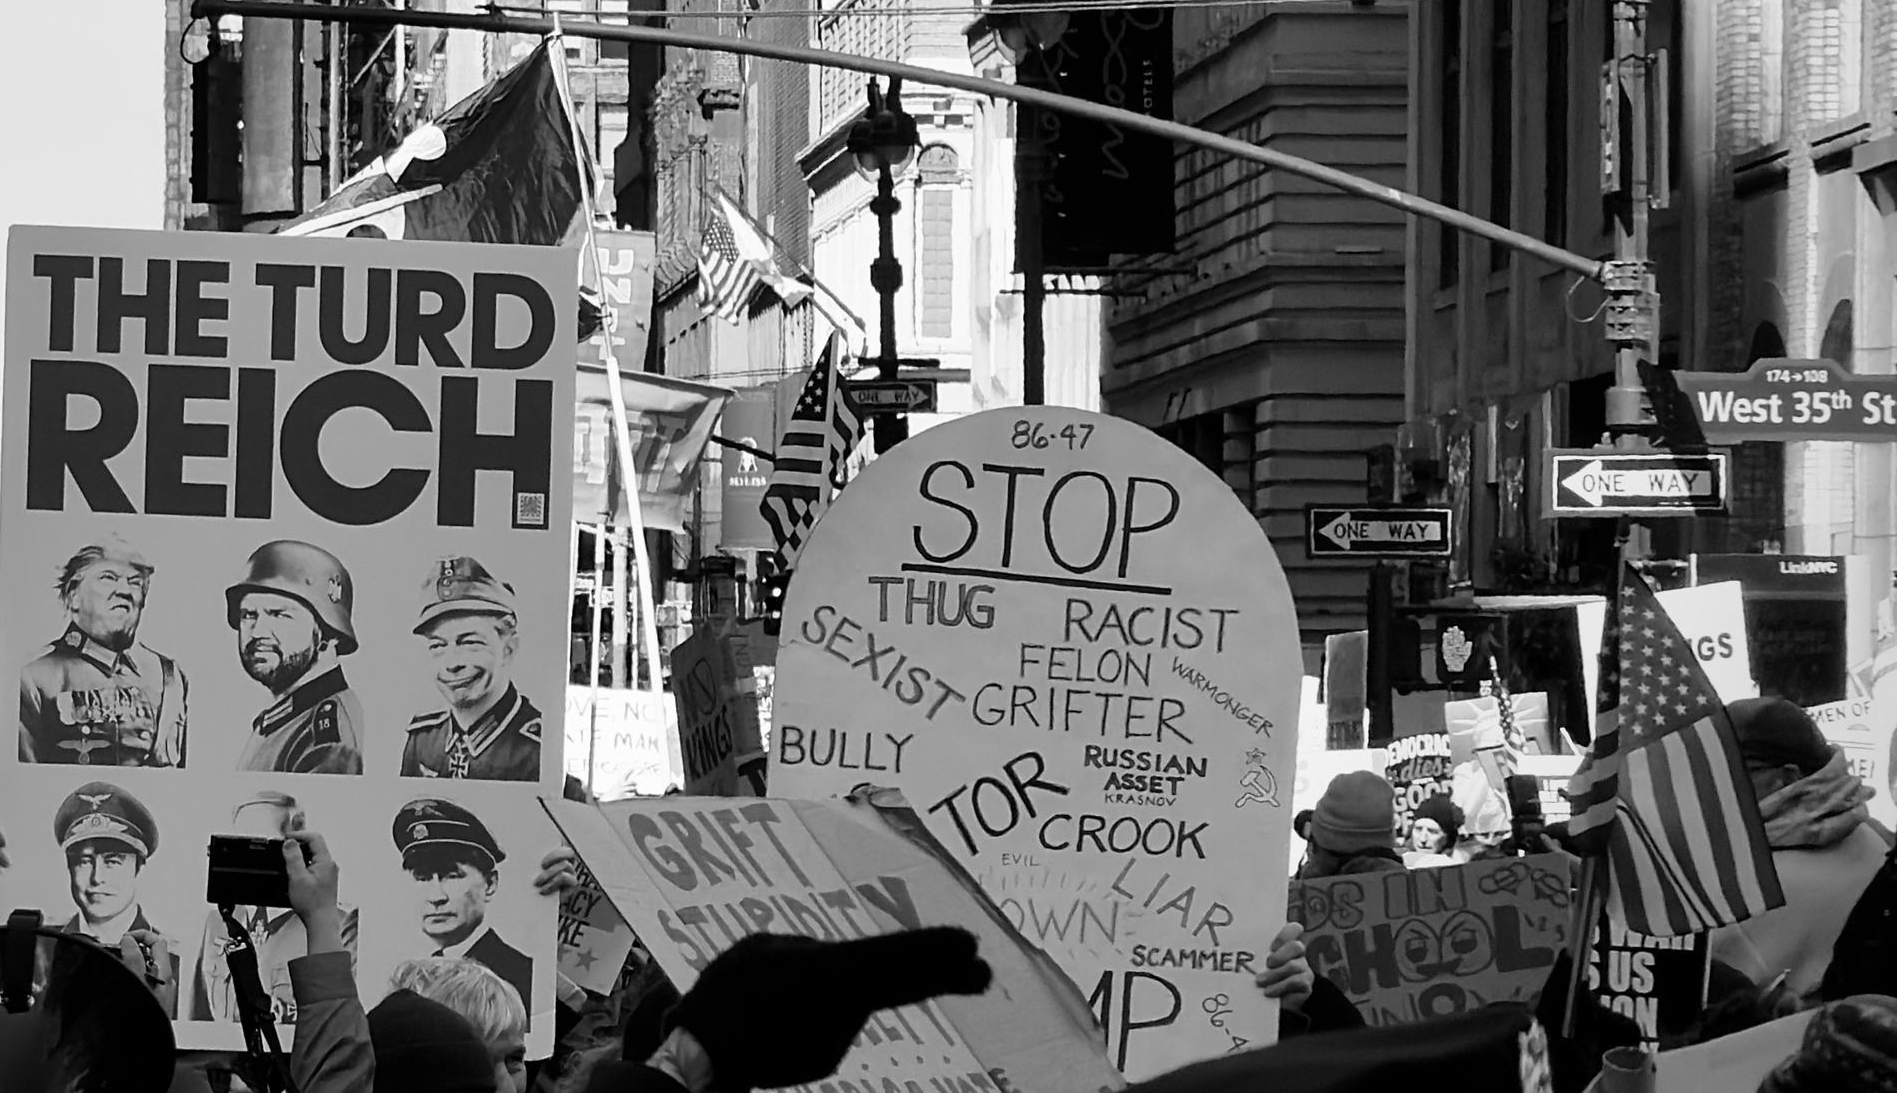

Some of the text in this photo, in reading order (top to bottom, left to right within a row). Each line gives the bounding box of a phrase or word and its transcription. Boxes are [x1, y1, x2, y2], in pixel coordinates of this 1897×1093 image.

[1140, 59, 1154, 113] OTELS
[33, 253, 230, 358] THE
[255, 262, 556, 370] TURD
[1698, 389, 1897, 425] West 35th St
[26, 359, 554, 530] REICH
[1582, 473, 1699, 493] ONE WAY
[913, 460, 1181, 579] STOP
[1334, 523, 1429, 539] ONE WAY
[1779, 561, 1838, 575] LinkNYC
[868, 575, 996, 629] THUG
[1064, 598, 1241, 653] RACIST
[801, 604, 967, 721] SEXIST
[1020, 643, 1152, 687] FELON
[1694, 632, 1733, 661] GS
[624, 701, 657, 723] NO
[972, 683, 1195, 744] GRIFTER
[1171, 656, 1275, 739] WARMONGER
[781, 726, 915, 774] BULLY
[1084, 744, 1208, 779] RUSSIAN
[928, 751, 1071, 857] TOR
[1104, 772, 1186, 796] ASSET
[1104, 793, 1177, 807] KRASNOV
[628, 802, 815, 892] GRIFT
[1001, 852, 1040, 868] EVIL
[1039, 813, 1210, 860] CROOK
[1111, 857, 1234, 947] LIAR
[1383, 868, 1468, 920] IN
[1130, 943, 1259, 976] SCAMMER
[1608, 950, 1655, 994] US
